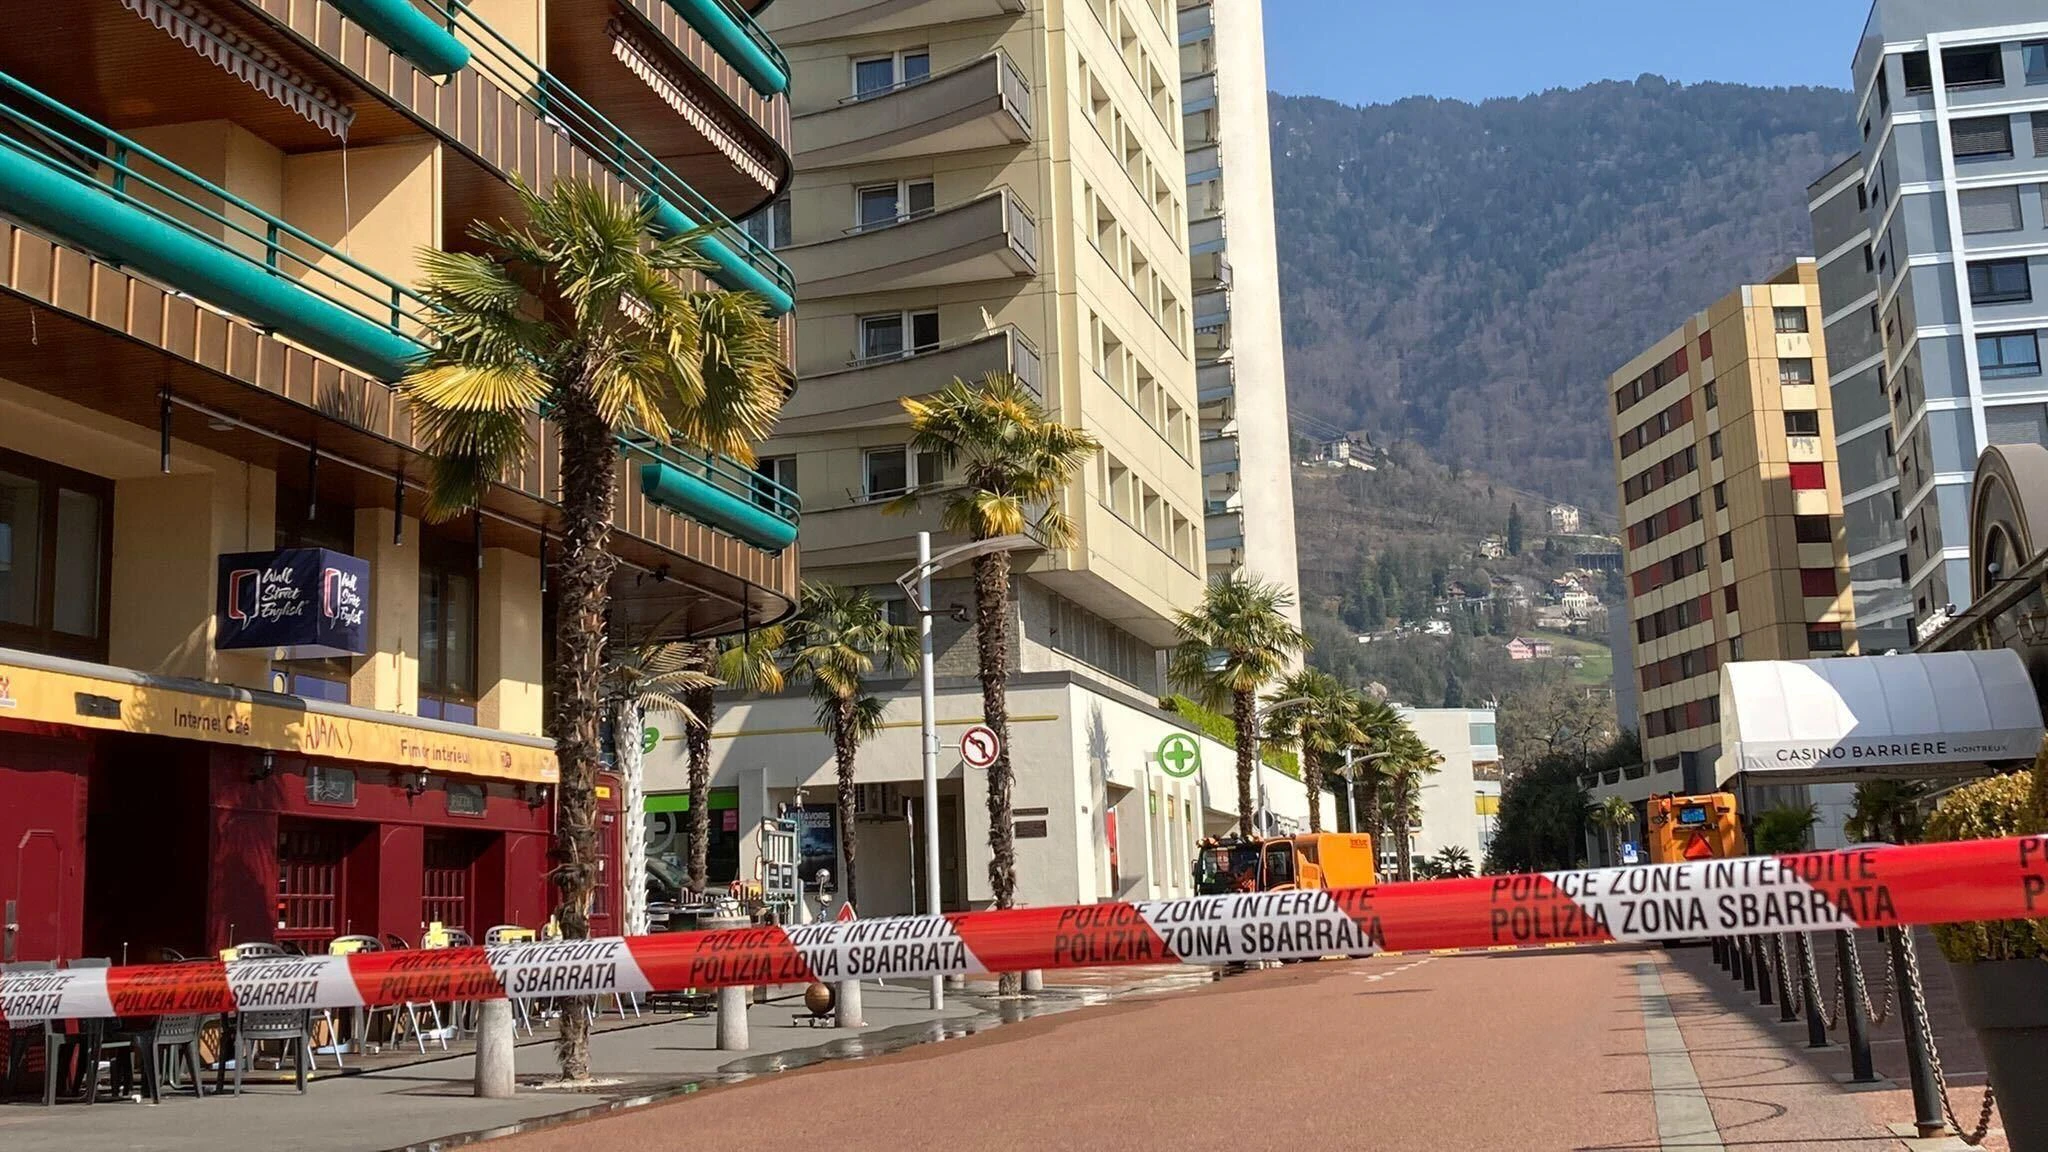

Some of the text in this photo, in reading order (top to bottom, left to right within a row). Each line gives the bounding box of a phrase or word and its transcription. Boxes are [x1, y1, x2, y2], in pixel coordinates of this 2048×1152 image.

[262, 567, 294, 584] Wall
[261, 584, 302, 601] Street
[261, 601, 304, 622] English
[174, 707, 250, 736] Internet Caé
[1776, 741, 2008, 762] CASINO BARRIÈRE MONTREUX
[1491, 852, 1878, 901] POLICE ZONE INTERDITE
[1057, 888, 1377, 929] POLICE ZONE INTERDITE
[1490, 885, 1897, 941] POLIZIA ZONA SBARRATA
[696, 928, 782, 952] POLICE
[780, 924, 842, 947] ZONE
[843, 916, 970, 943] INTERDITE
[1053, 916, 1386, 964] POLIZIA ZONA SBARRATA
[232, 961, 330, 981] INTERDITE
[390, 950, 465, 970] POLICE
[460, 947, 512, 967] ZONE
[514, 941, 625, 965] INTERDITE
[689, 941, 968, 984] POLIZIA ZONA SBARRATA
[113, 980, 319, 1013] POLIZIA ZONA SBARRATA
[378, 963, 616, 1000] POLIZIA ZONA SBARRATA
